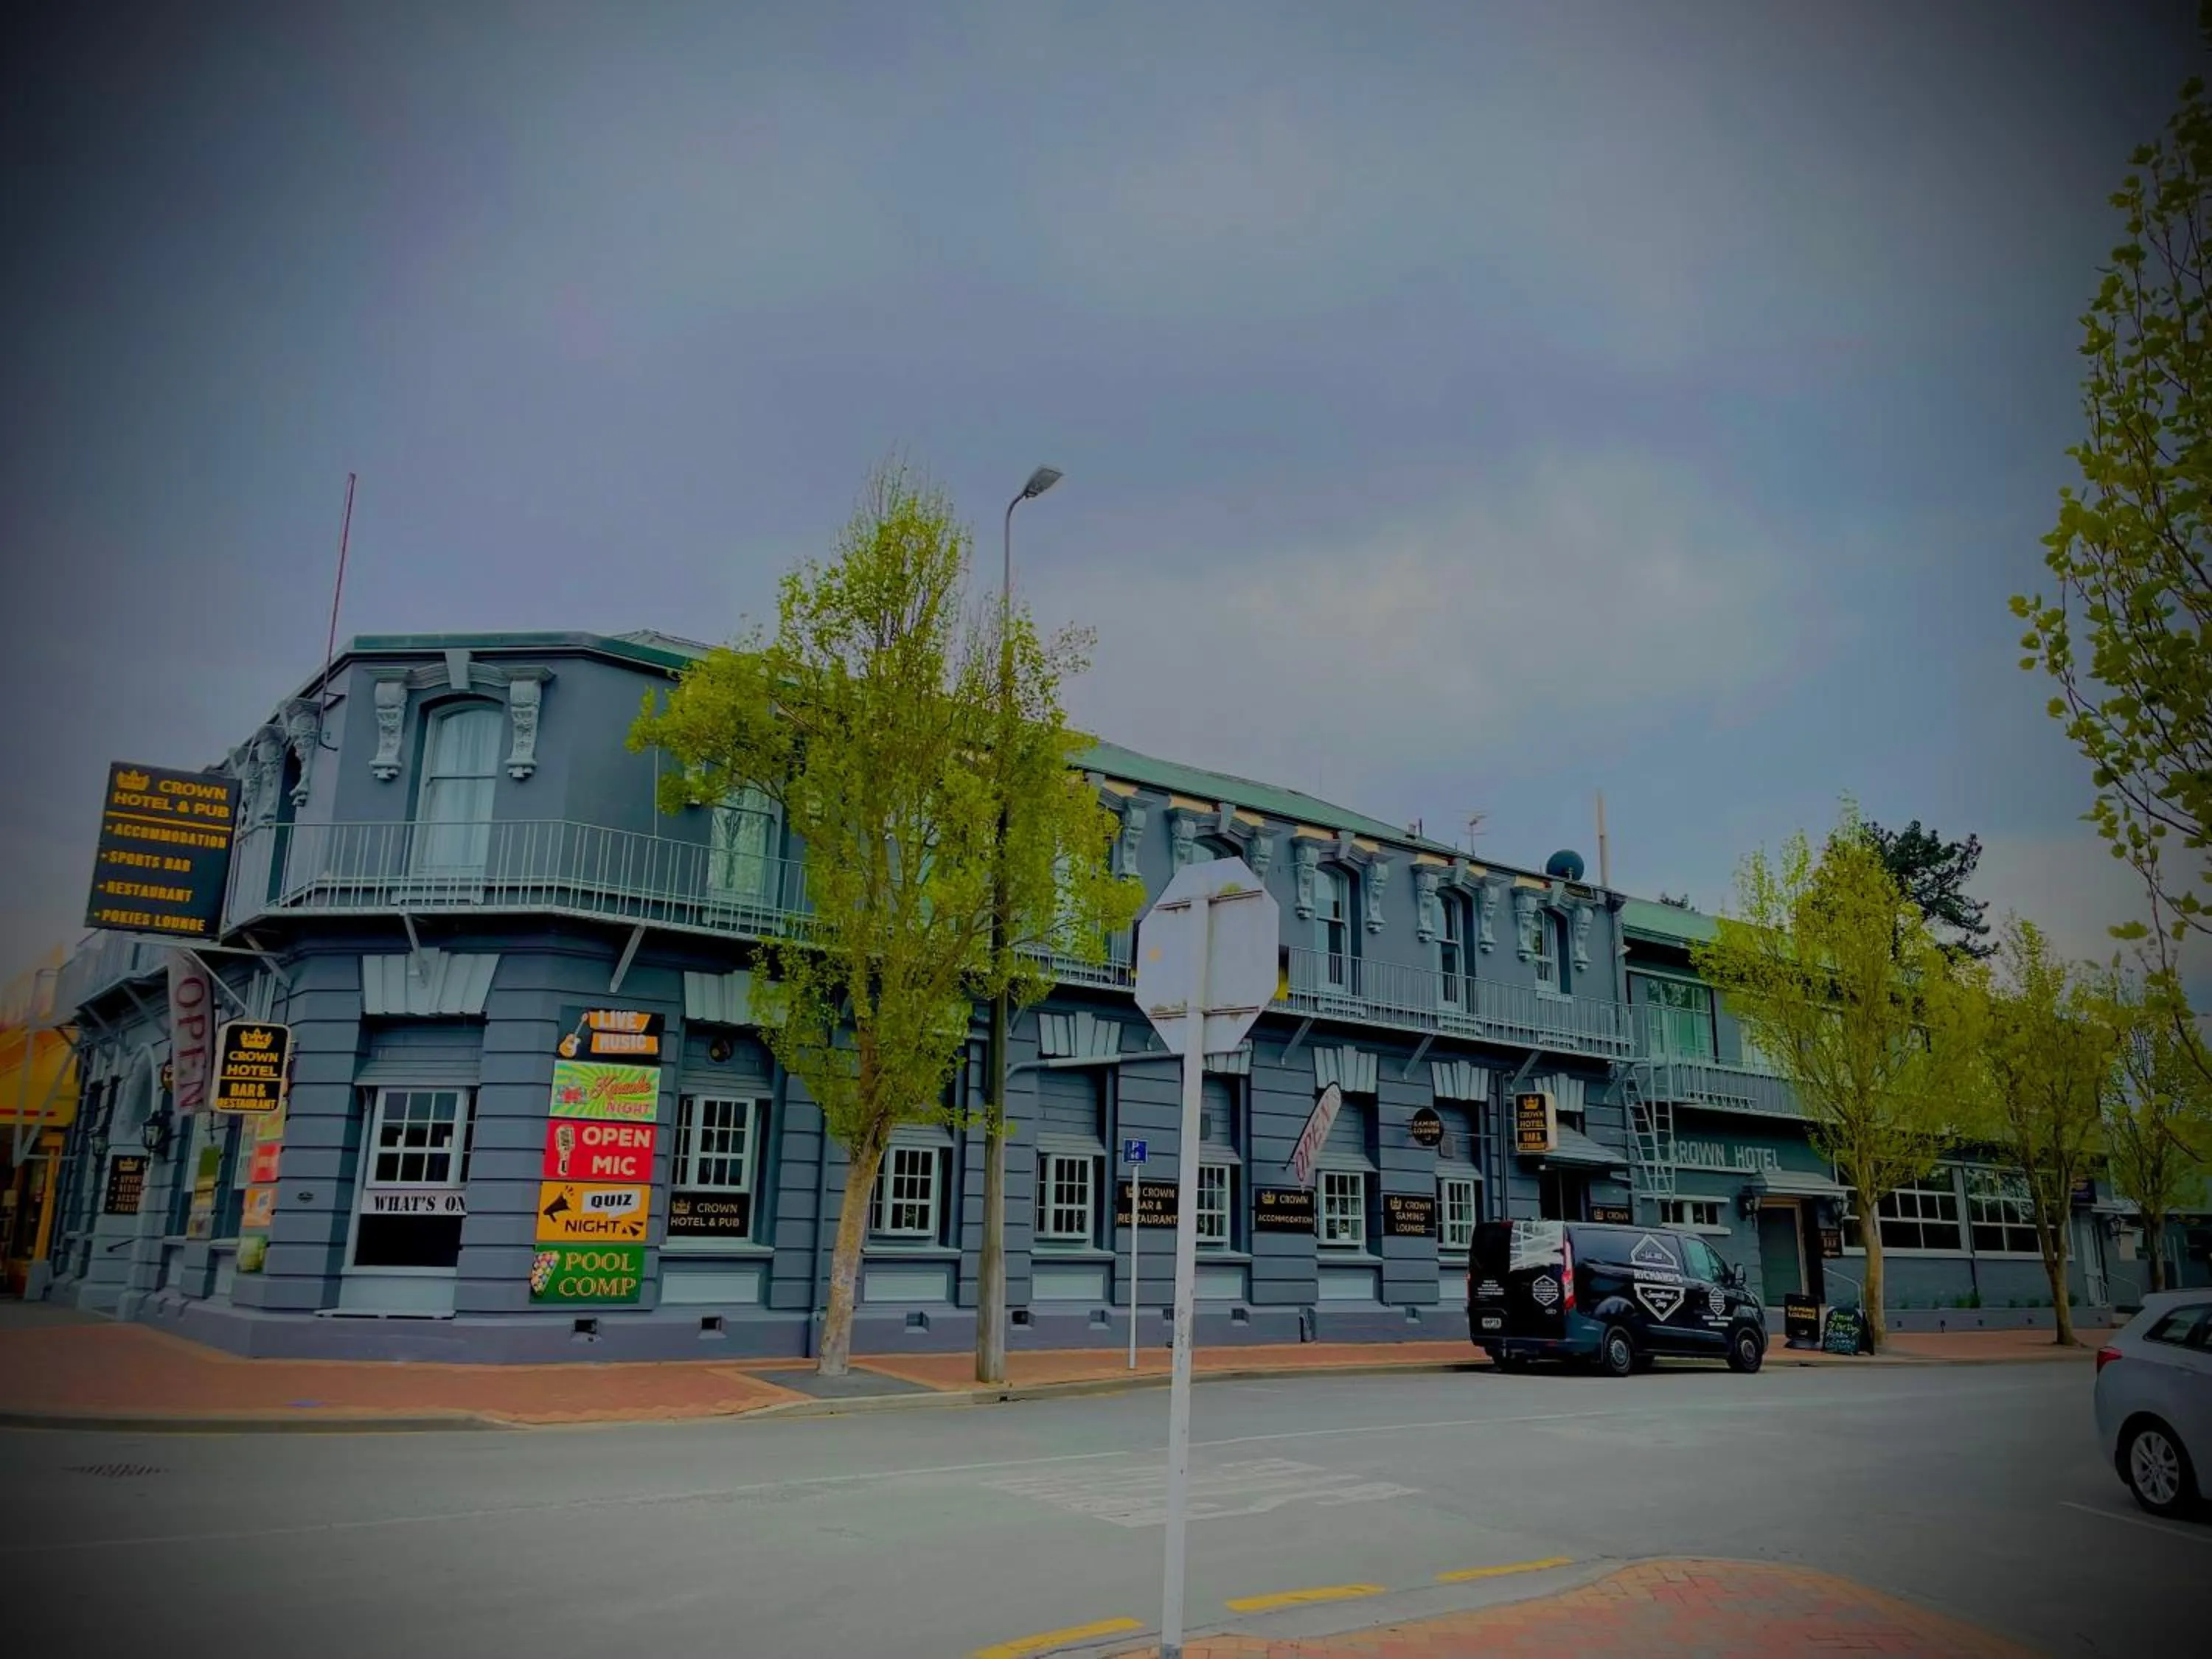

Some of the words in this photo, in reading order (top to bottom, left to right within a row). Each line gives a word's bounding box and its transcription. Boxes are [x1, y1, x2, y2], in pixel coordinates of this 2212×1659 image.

[159, 779, 228, 801] CROWN
[114, 792, 173, 811] HOTEL
[177, 800, 189, 814] &
[194, 802, 230, 818] PUB
[114, 822, 227, 849] ACCOMMODATION
[109, 850, 160, 869] SPORTS
[164, 857, 191, 873] BAR
[105, 880, 193, 903] RESTAURANT
[101, 909, 151, 927] POKIES
[153, 914, 206, 933] LOUNGE
[599, 1009, 639, 1030] LIVE
[600, 1033, 647, 1051] MUSIC
[228, 1051, 279, 1062] CROWN
[226, 1064, 278, 1077] HOTEL
[229, 1083, 254, 1097] BAR
[582, 1126, 652, 1148] OPEN
[592, 1155, 636, 1175] MIC
[1734, 1144, 1781, 1171] HOTEL
[591, 1194, 633, 1208] QUIZ
[1142, 1186, 1175, 1198] CROWN
[1279, 1194, 1310, 1204] CROWN
[375, 1194, 436, 1212] WHAT'S
[697, 1203, 738, 1214] CROWN
[1405, 1200, 1431, 1211] CROWN
[670, 1215, 706, 1228] HOTEL
[709, 1217, 717, 1228] &
[719, 1217, 740, 1228] PUB
[1395, 1211, 1425, 1222] GAMING
[565, 1220, 621, 1234] NIGHT
[564, 1251, 636, 1273] POOL
[558, 1276, 637, 1298] COMP
